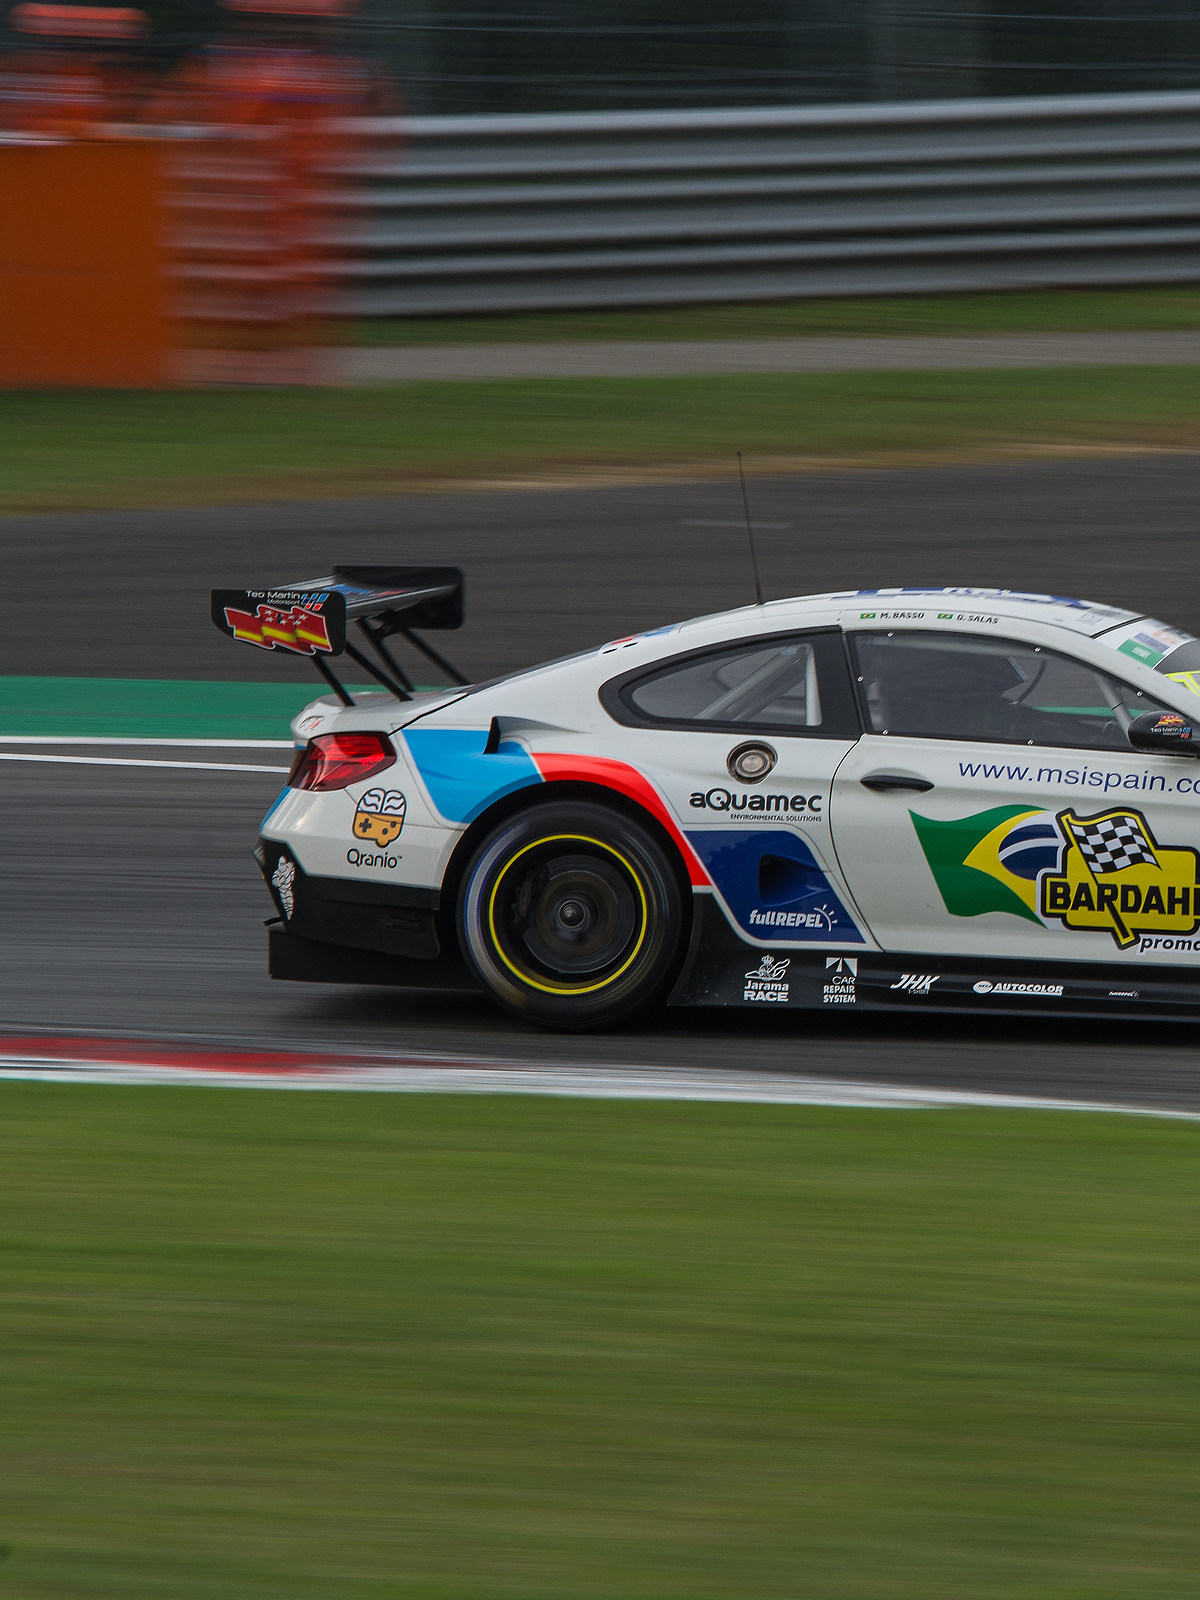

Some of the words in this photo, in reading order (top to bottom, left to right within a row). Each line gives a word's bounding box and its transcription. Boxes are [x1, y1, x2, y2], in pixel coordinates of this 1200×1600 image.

[246, 590, 265, 598] Teo
[267, 591, 300, 600] Martin
[967, 616, 999, 624] SALAS
[689, 788, 823, 812] aQuamec
[730, 813, 784, 821] ENVIRONMENTAL
[346, 848, 398, 869] Qranio
[750, 909, 824, 929] fullREPEL
[744, 980, 790, 992] Jarama
[832, 976, 856, 985] CAR
[890, 974, 941, 990] JHK
[823, 985, 856, 994] REPAIR
[994, 982, 1064, 994] AUTOCOLOR
[743, 990, 789, 1002] RACE
[823, 994, 856, 1004] SYSTEM
